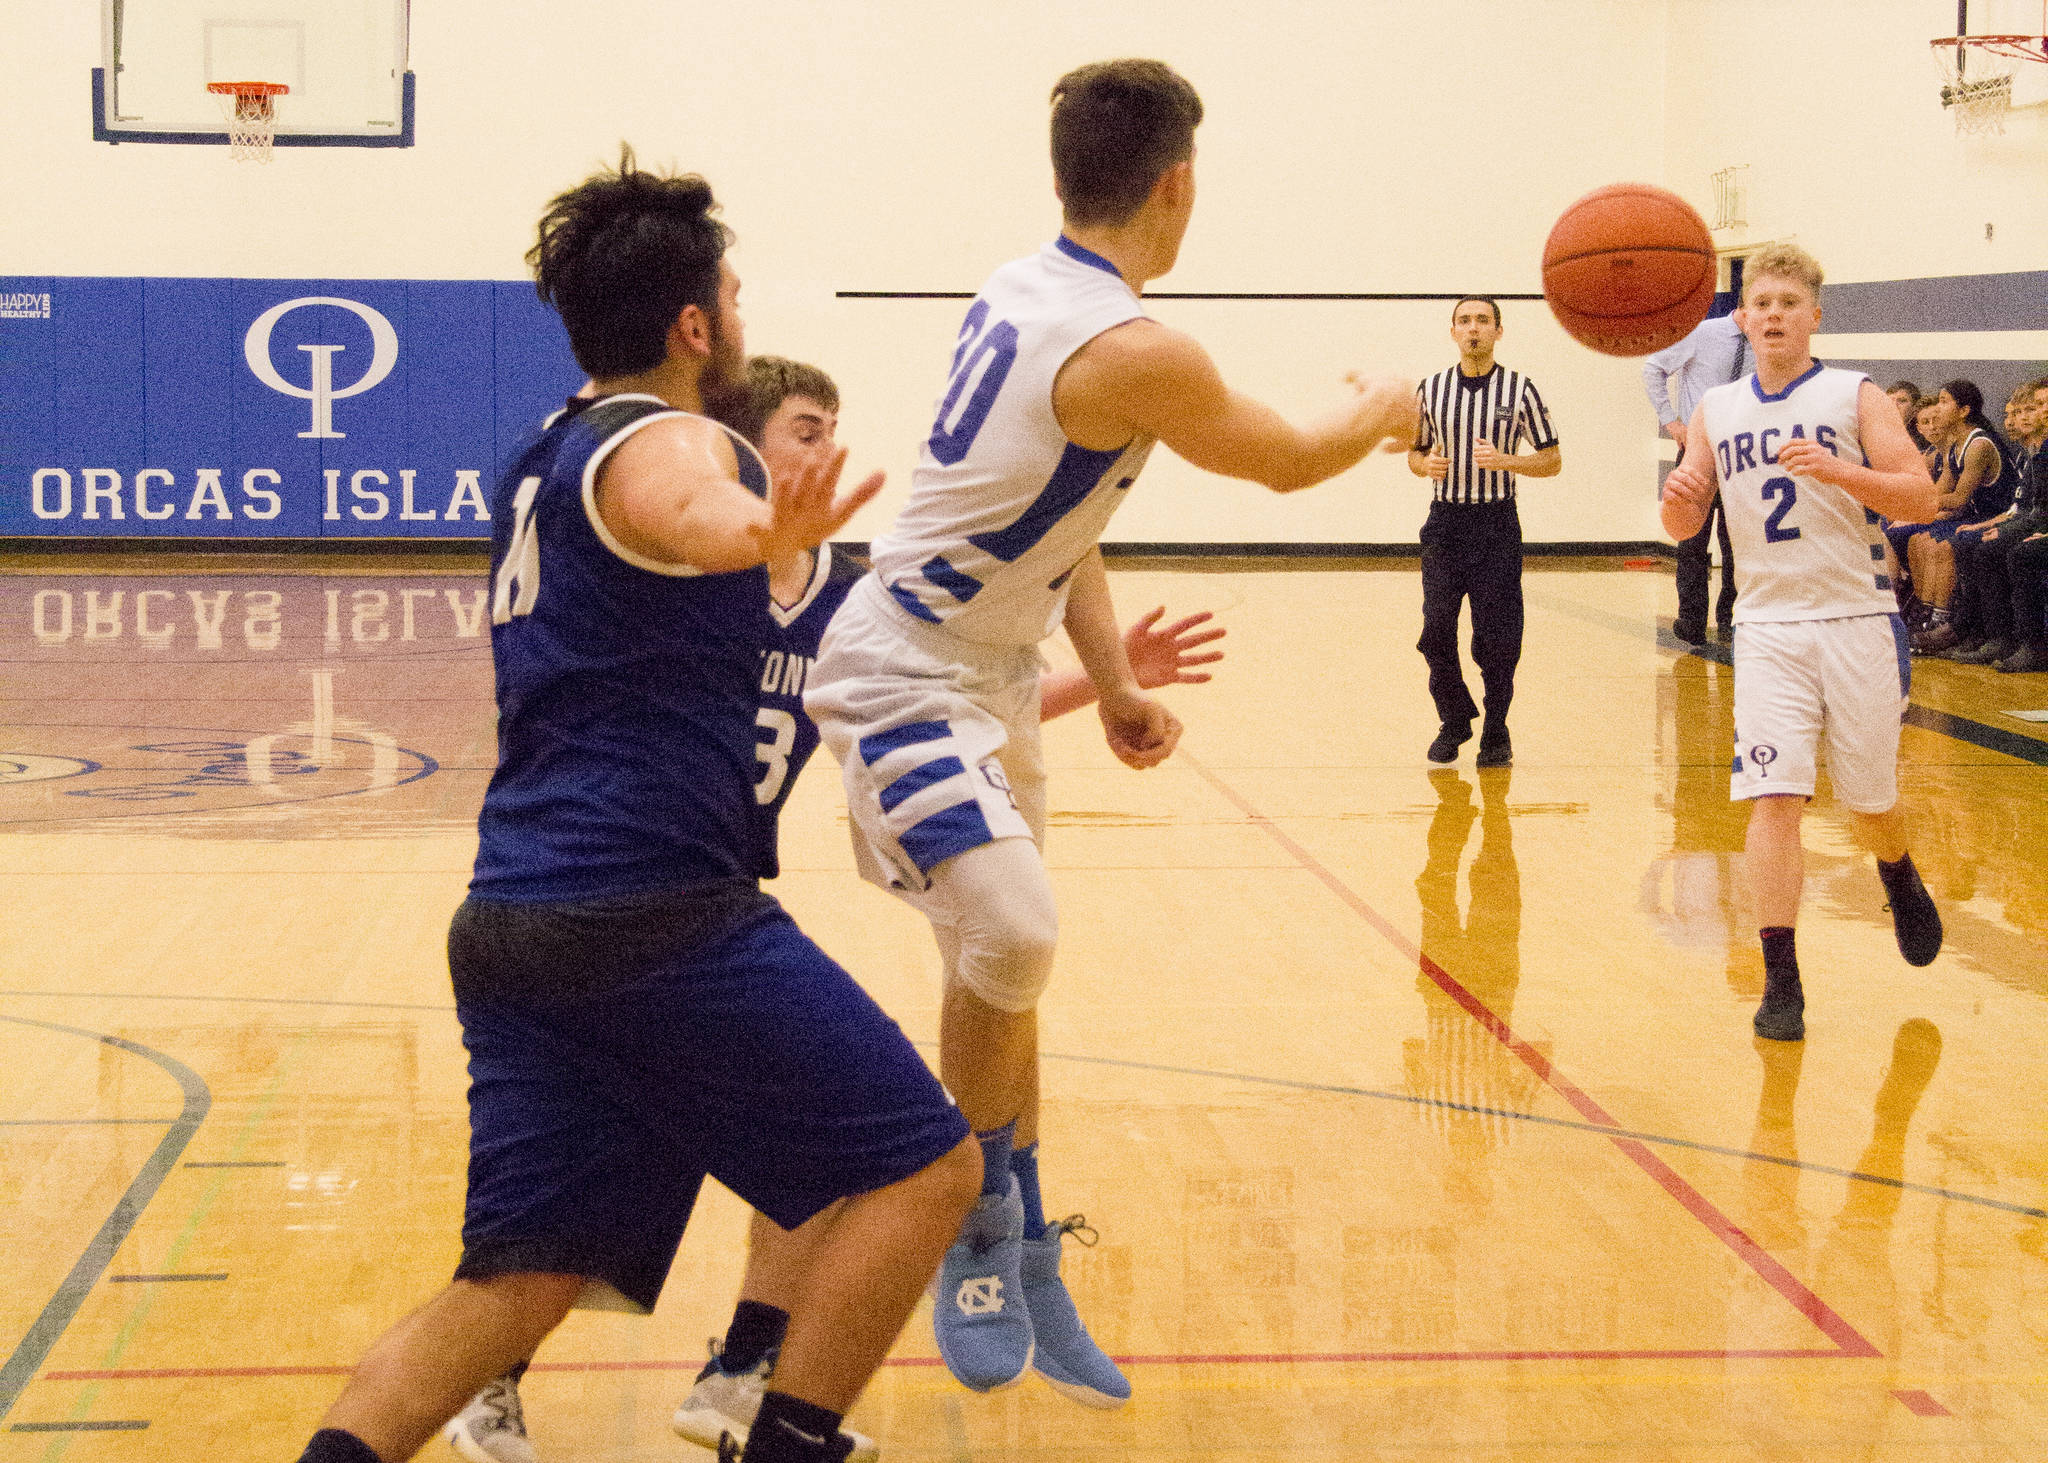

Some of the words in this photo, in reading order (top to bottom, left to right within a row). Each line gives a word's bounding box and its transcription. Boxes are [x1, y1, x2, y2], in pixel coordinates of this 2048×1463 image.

[0, 293, 42, 310] HAPPY
[0, 310, 42, 319] HEALTHY
[31, 467, 282, 521] ORCAS
[323, 469, 492, 521] ISLA
[1761, 476, 1801, 543] 2
